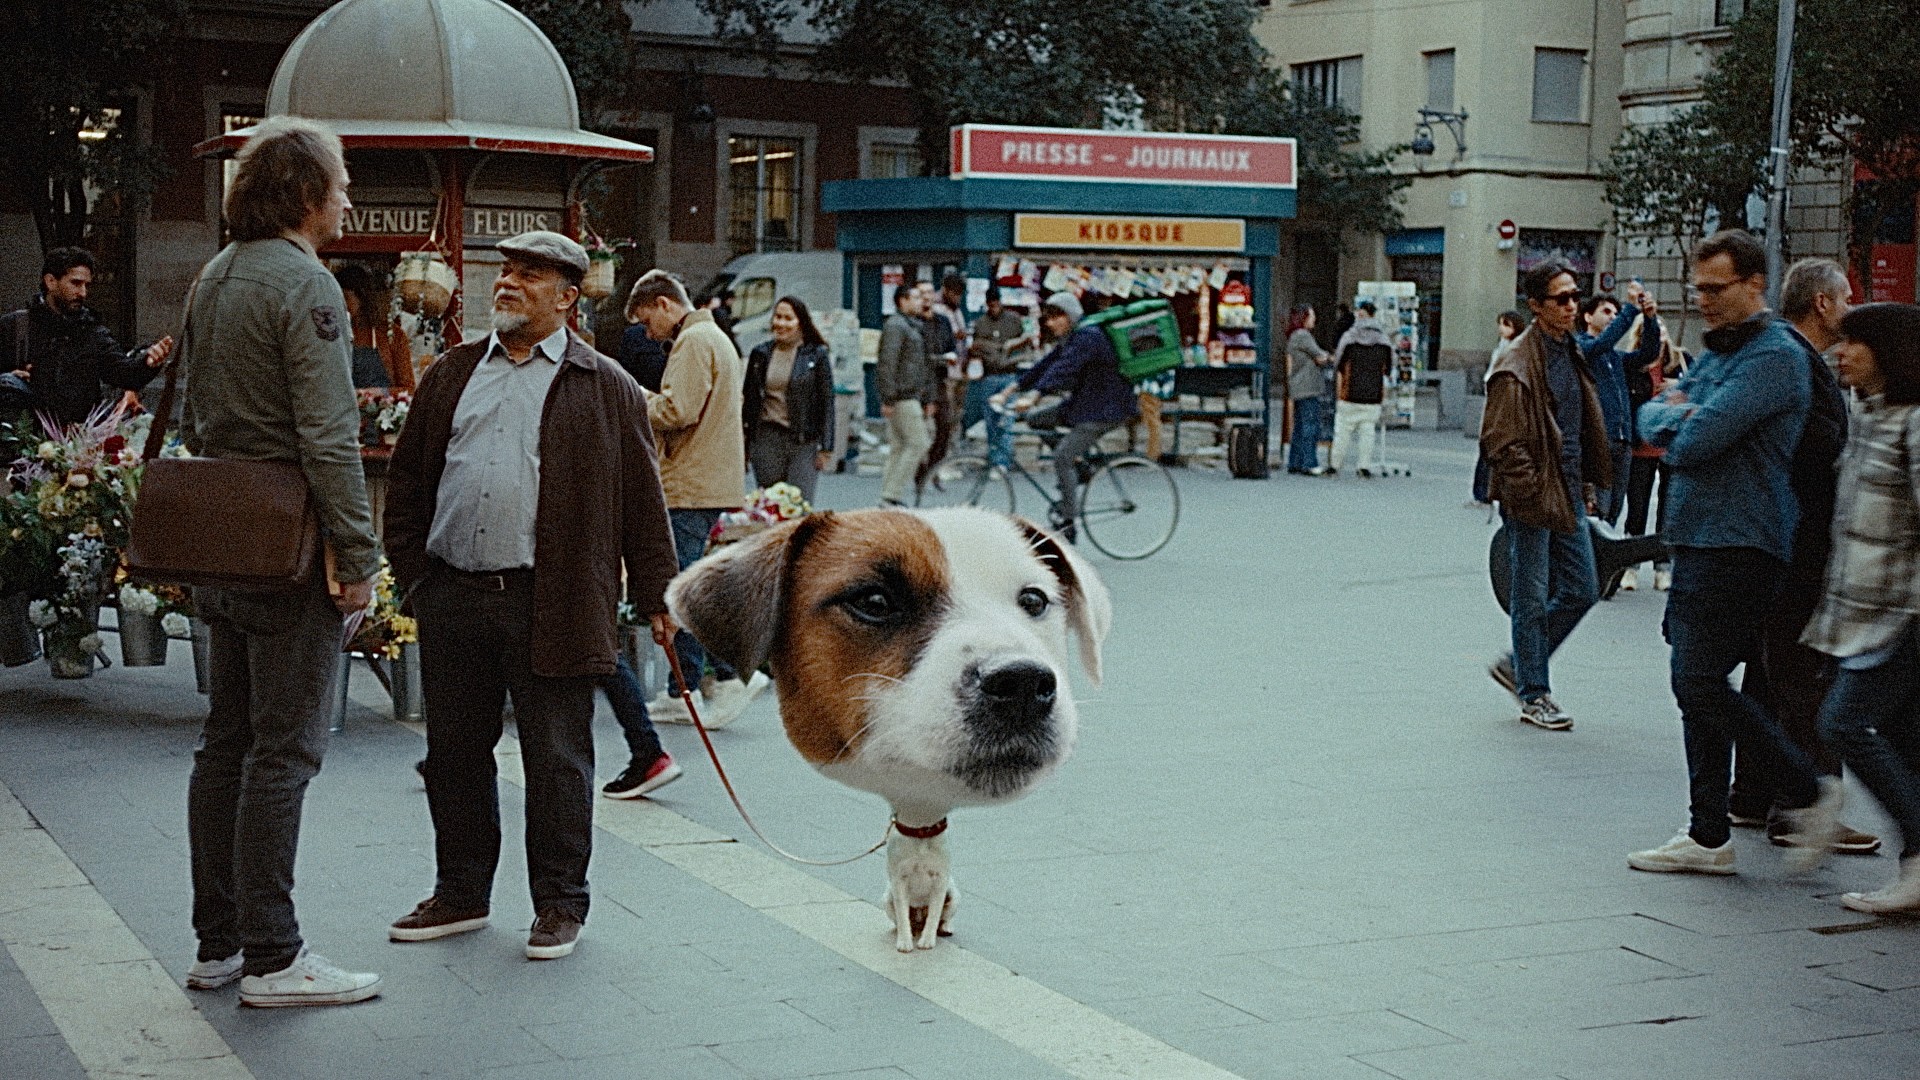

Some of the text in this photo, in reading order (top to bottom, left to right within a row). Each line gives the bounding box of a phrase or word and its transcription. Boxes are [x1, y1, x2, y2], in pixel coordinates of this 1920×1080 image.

[1001, 141, 1093, 165] PRESSE
[1126, 146, 1250, 171] JOURNAUX
[341, 208, 430, 233] AVENUE
[474, 211, 548, 234] FLEURS
[1079, 223, 1184, 242] KIOSQUE
